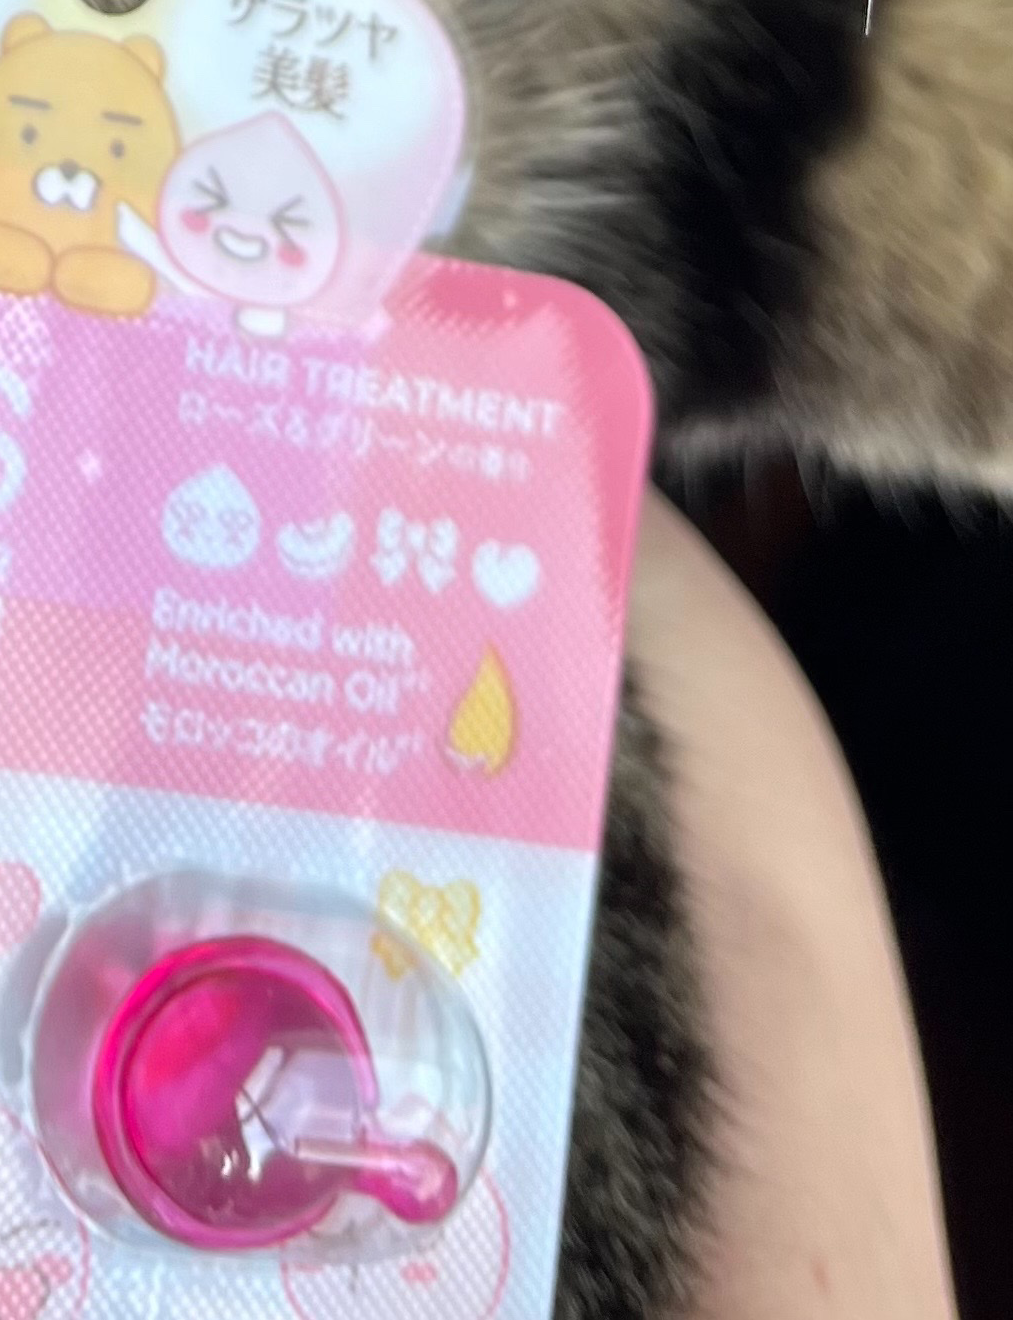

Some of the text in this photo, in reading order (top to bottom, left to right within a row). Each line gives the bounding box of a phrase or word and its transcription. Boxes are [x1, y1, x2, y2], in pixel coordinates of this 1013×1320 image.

[252, 43, 349, 121] 美髪
[185, 335, 564, 439] HAIR TREATMENT
[152, 586, 415, 667] Enriched with
[145, 634, 336, 707] Moroccan
